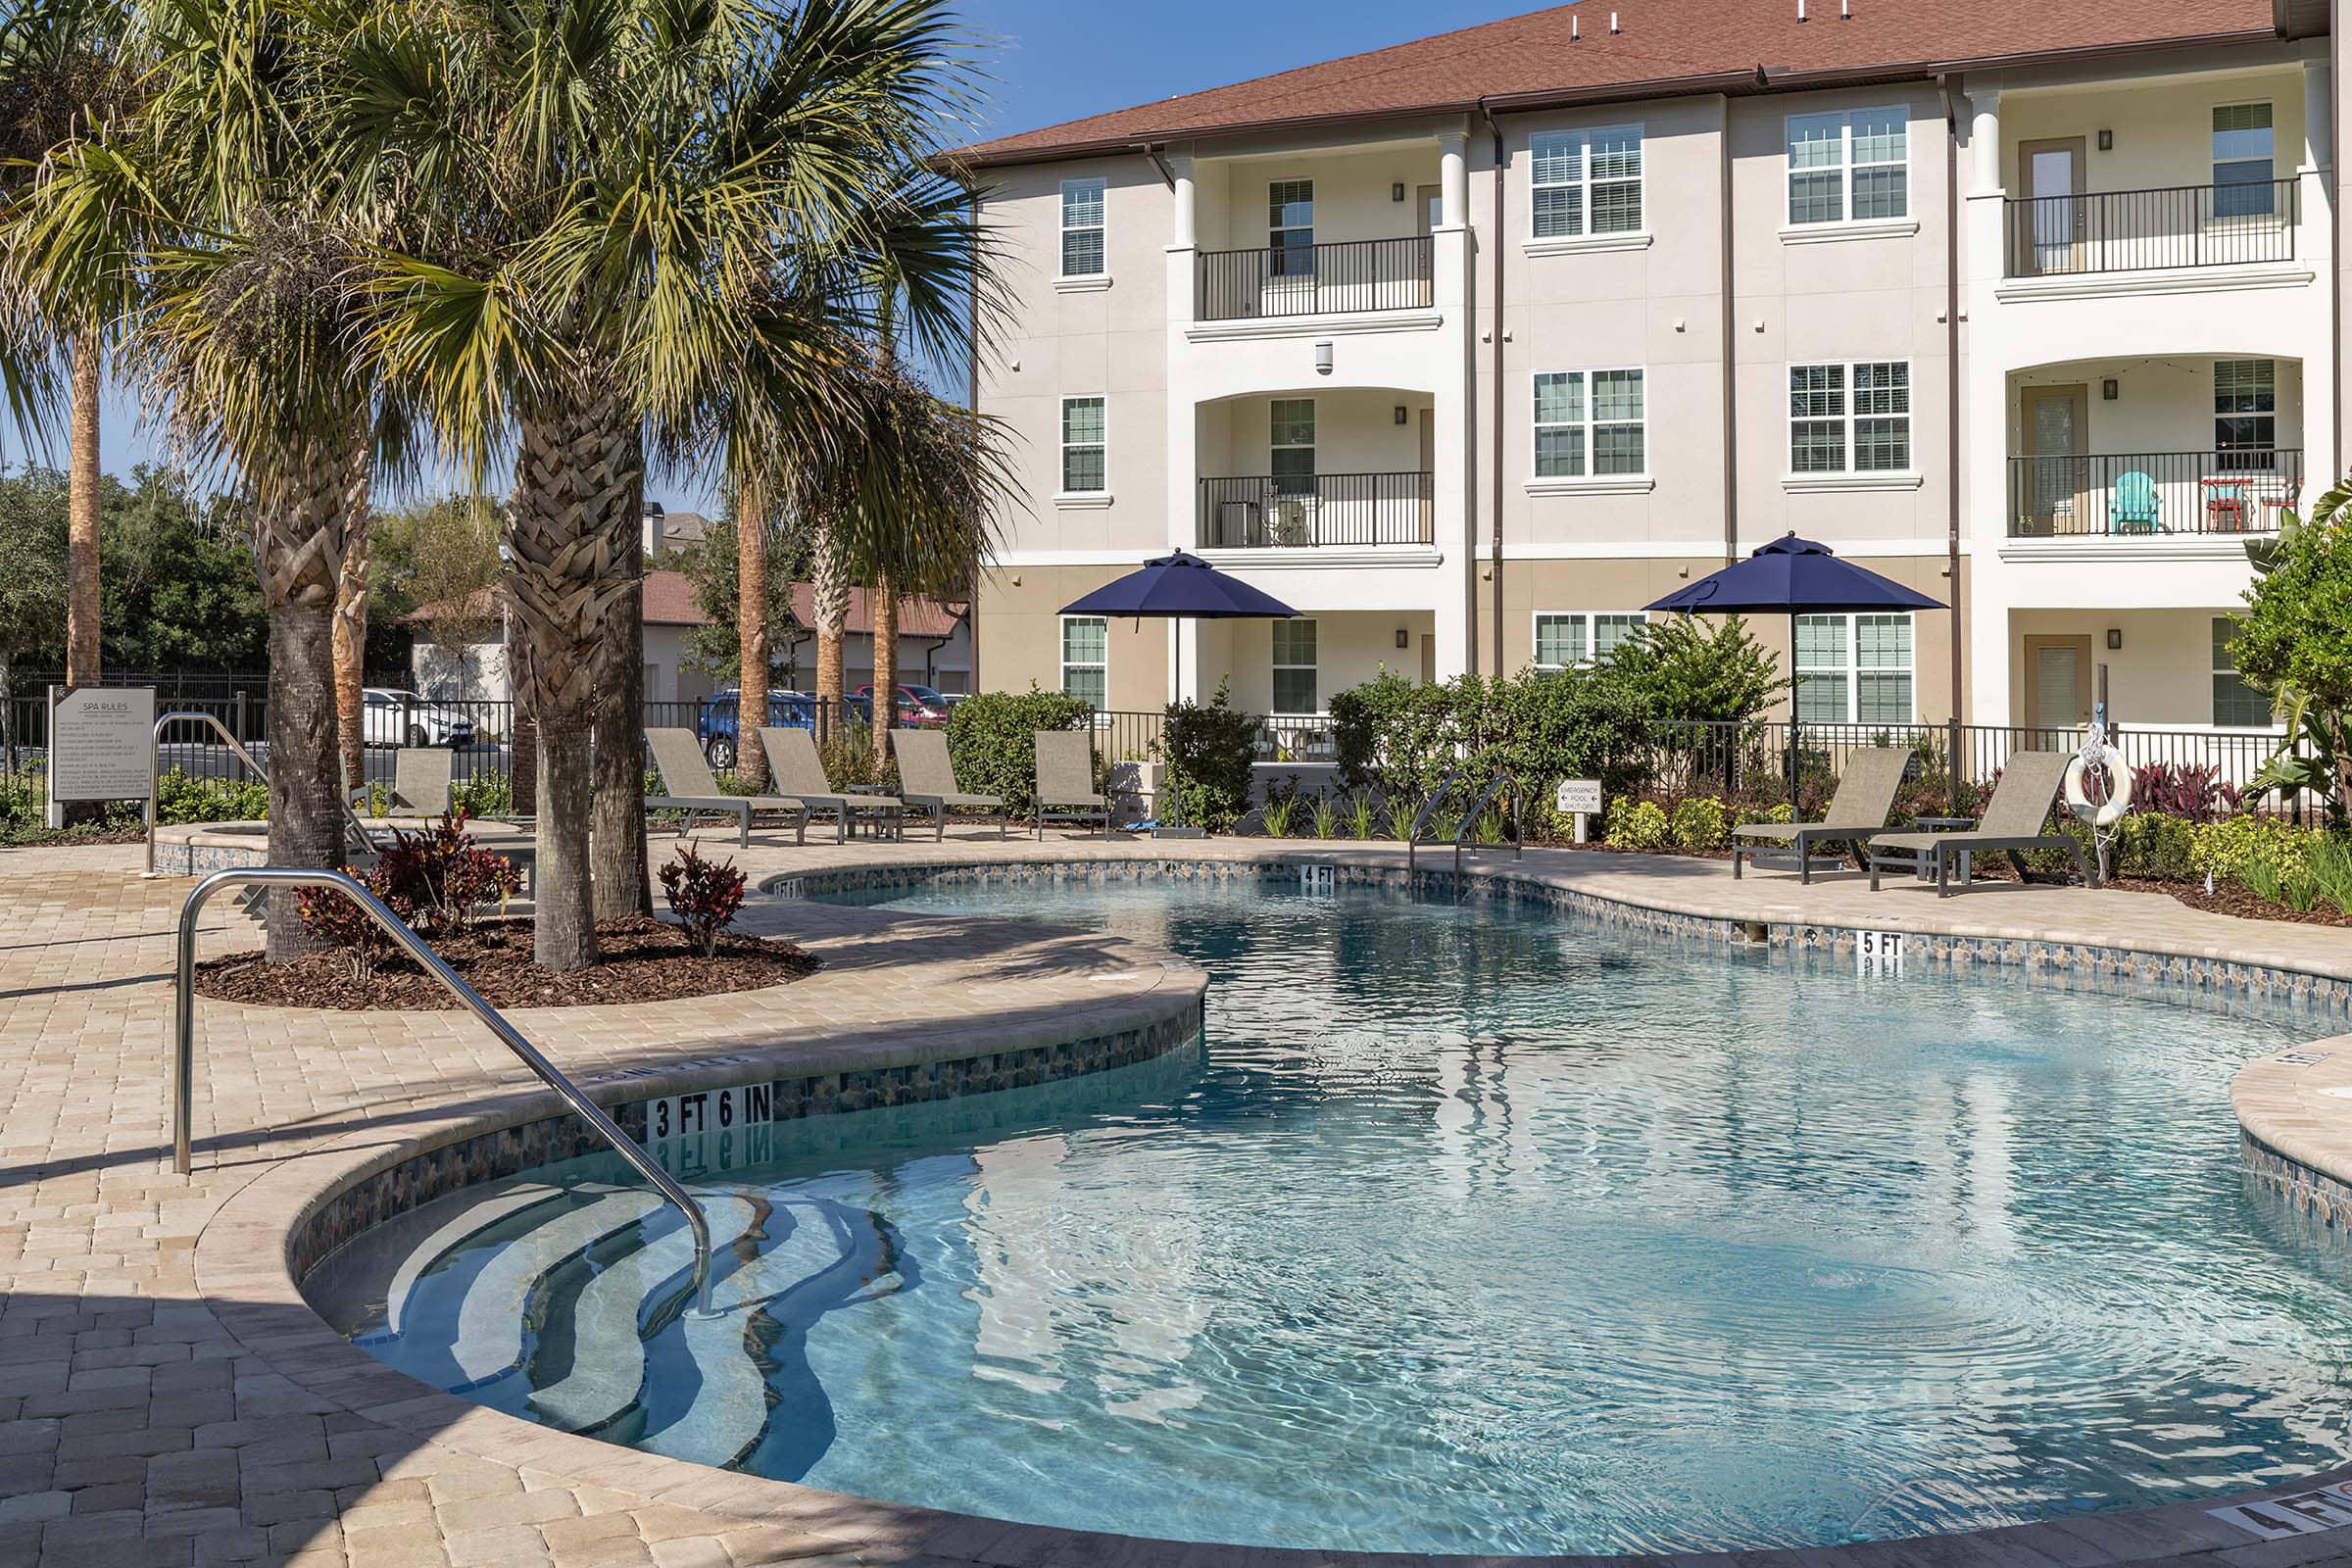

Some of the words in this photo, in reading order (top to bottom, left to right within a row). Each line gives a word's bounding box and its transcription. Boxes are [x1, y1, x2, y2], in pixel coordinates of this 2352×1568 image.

[1305, 865, 1313, 882] 4
[1318, 866, 1333, 883] FT
[1864, 932, 1873, 954] 5
[1882, 933, 1901, 956] FT
[657, 1100, 669, 1138] 3
[680, 1093, 708, 1134] FT
[719, 1090, 732, 1127] 6
[745, 1085, 770, 1124] IN
[2235, 1506, 2303, 1533] 4
